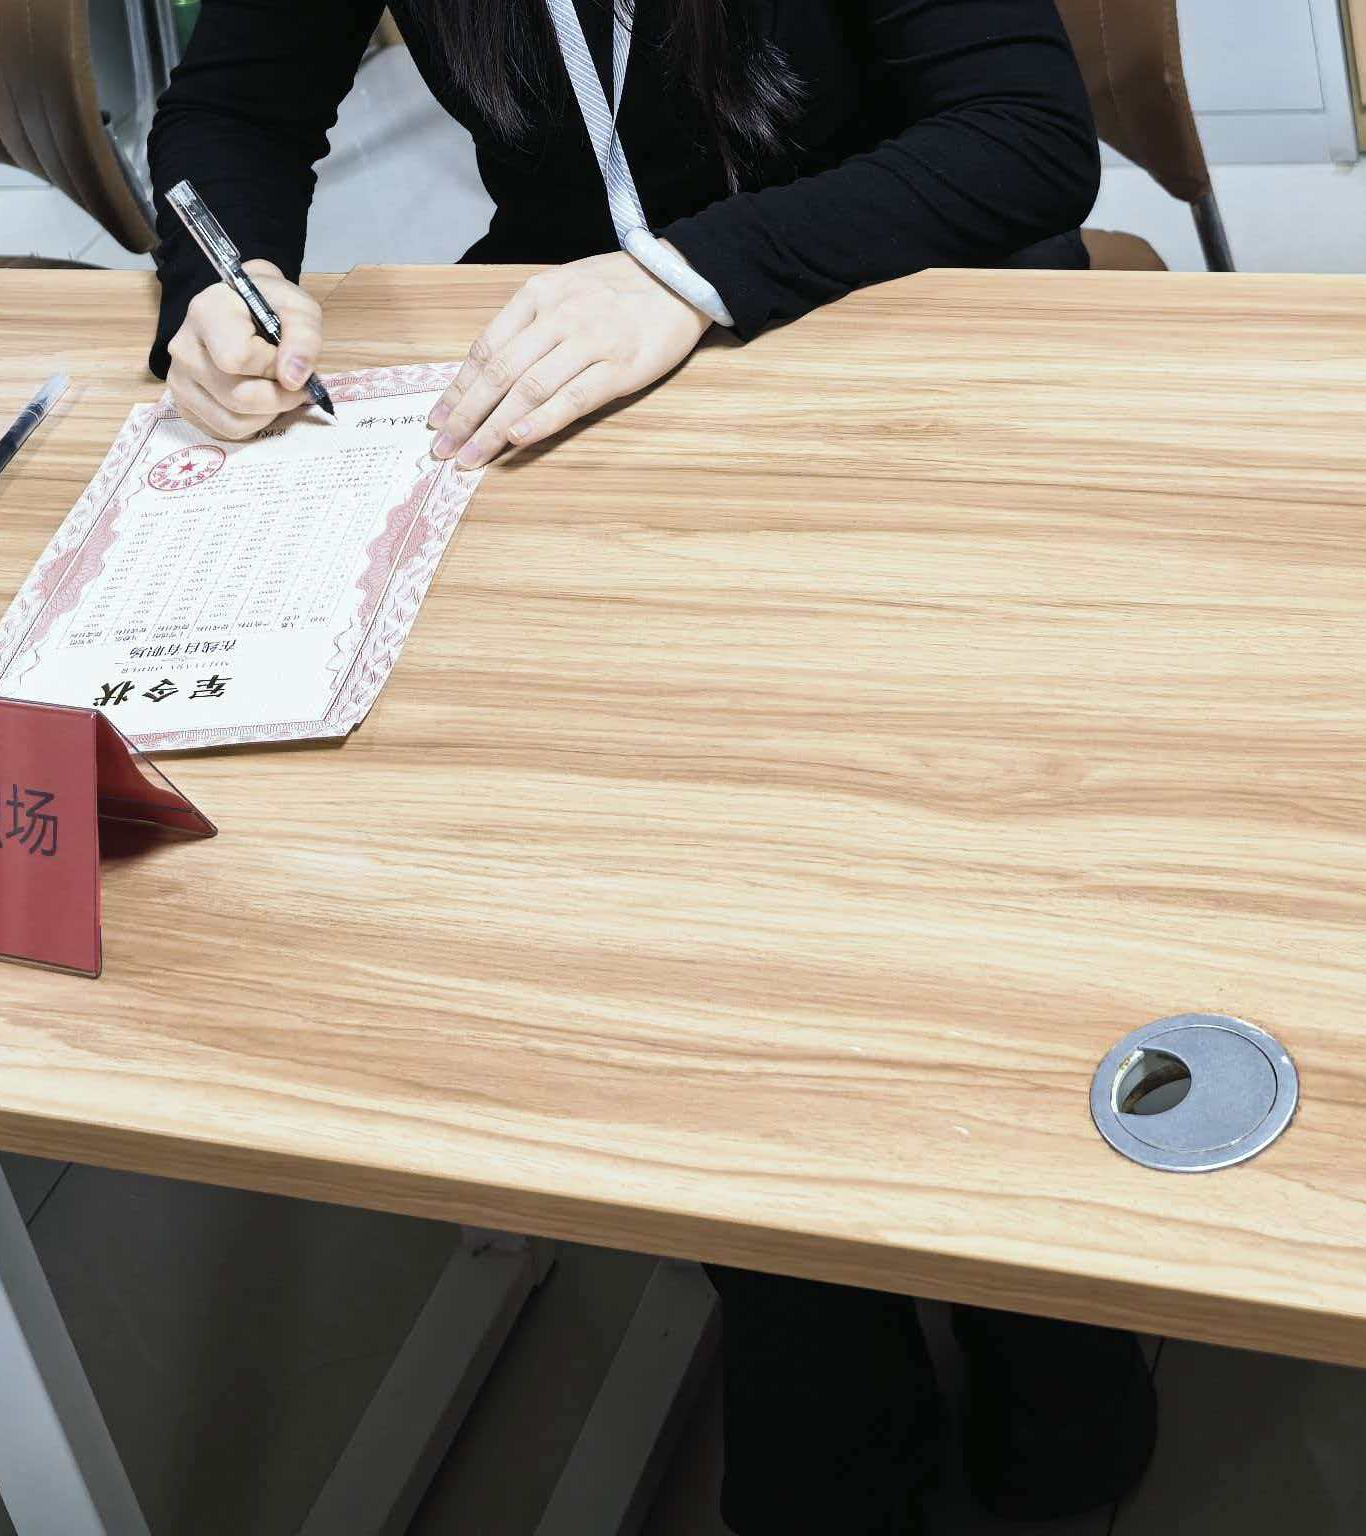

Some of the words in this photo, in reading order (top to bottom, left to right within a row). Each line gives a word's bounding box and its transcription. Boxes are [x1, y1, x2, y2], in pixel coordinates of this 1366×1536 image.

[128, 638, 238, 659] 在线自有职场
[91, 674, 233, 707] 军令状
